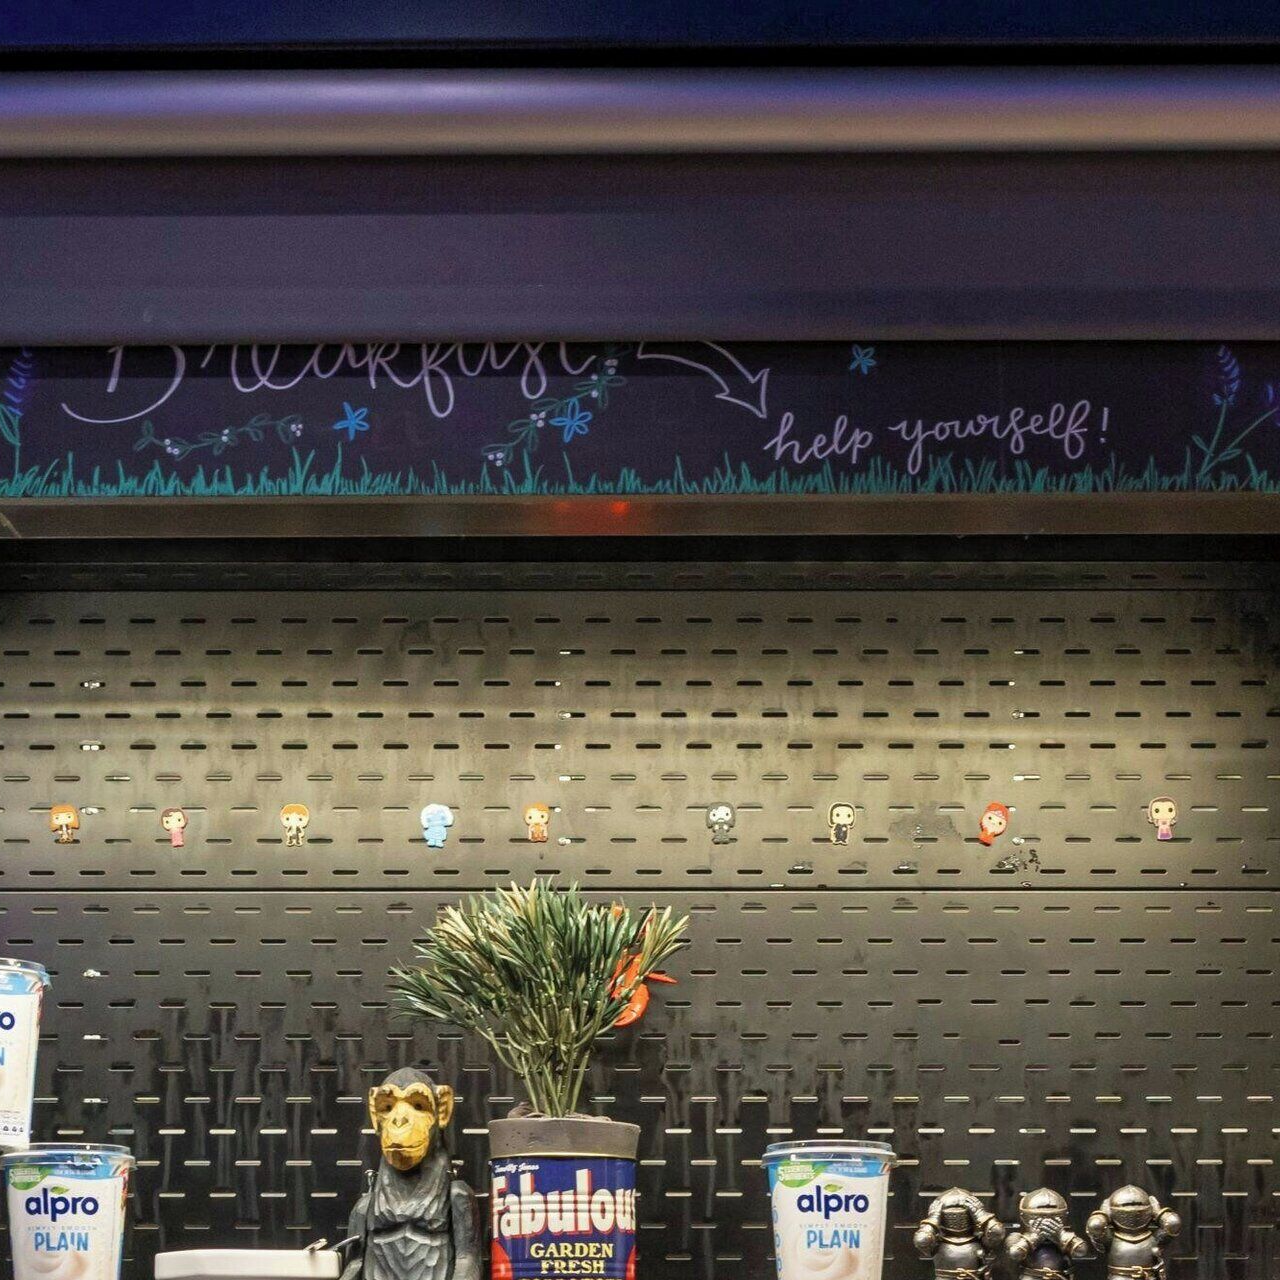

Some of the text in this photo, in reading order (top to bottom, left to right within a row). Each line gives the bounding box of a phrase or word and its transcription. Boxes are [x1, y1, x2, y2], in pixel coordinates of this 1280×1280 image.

[761, 399, 1111, 476] help yourself!
[25, 1188, 99, 1222] alpro
[492, 1168, 636, 1239] Fabulou
[797, 1185, 869, 1220] alpro
[34, 1232, 89, 1251] PLAIN
[529, 1242, 614, 1258] GARDEN
[806, 1230, 861, 1249] PLAIN
[540, 1259, 606, 1274] FRESH
